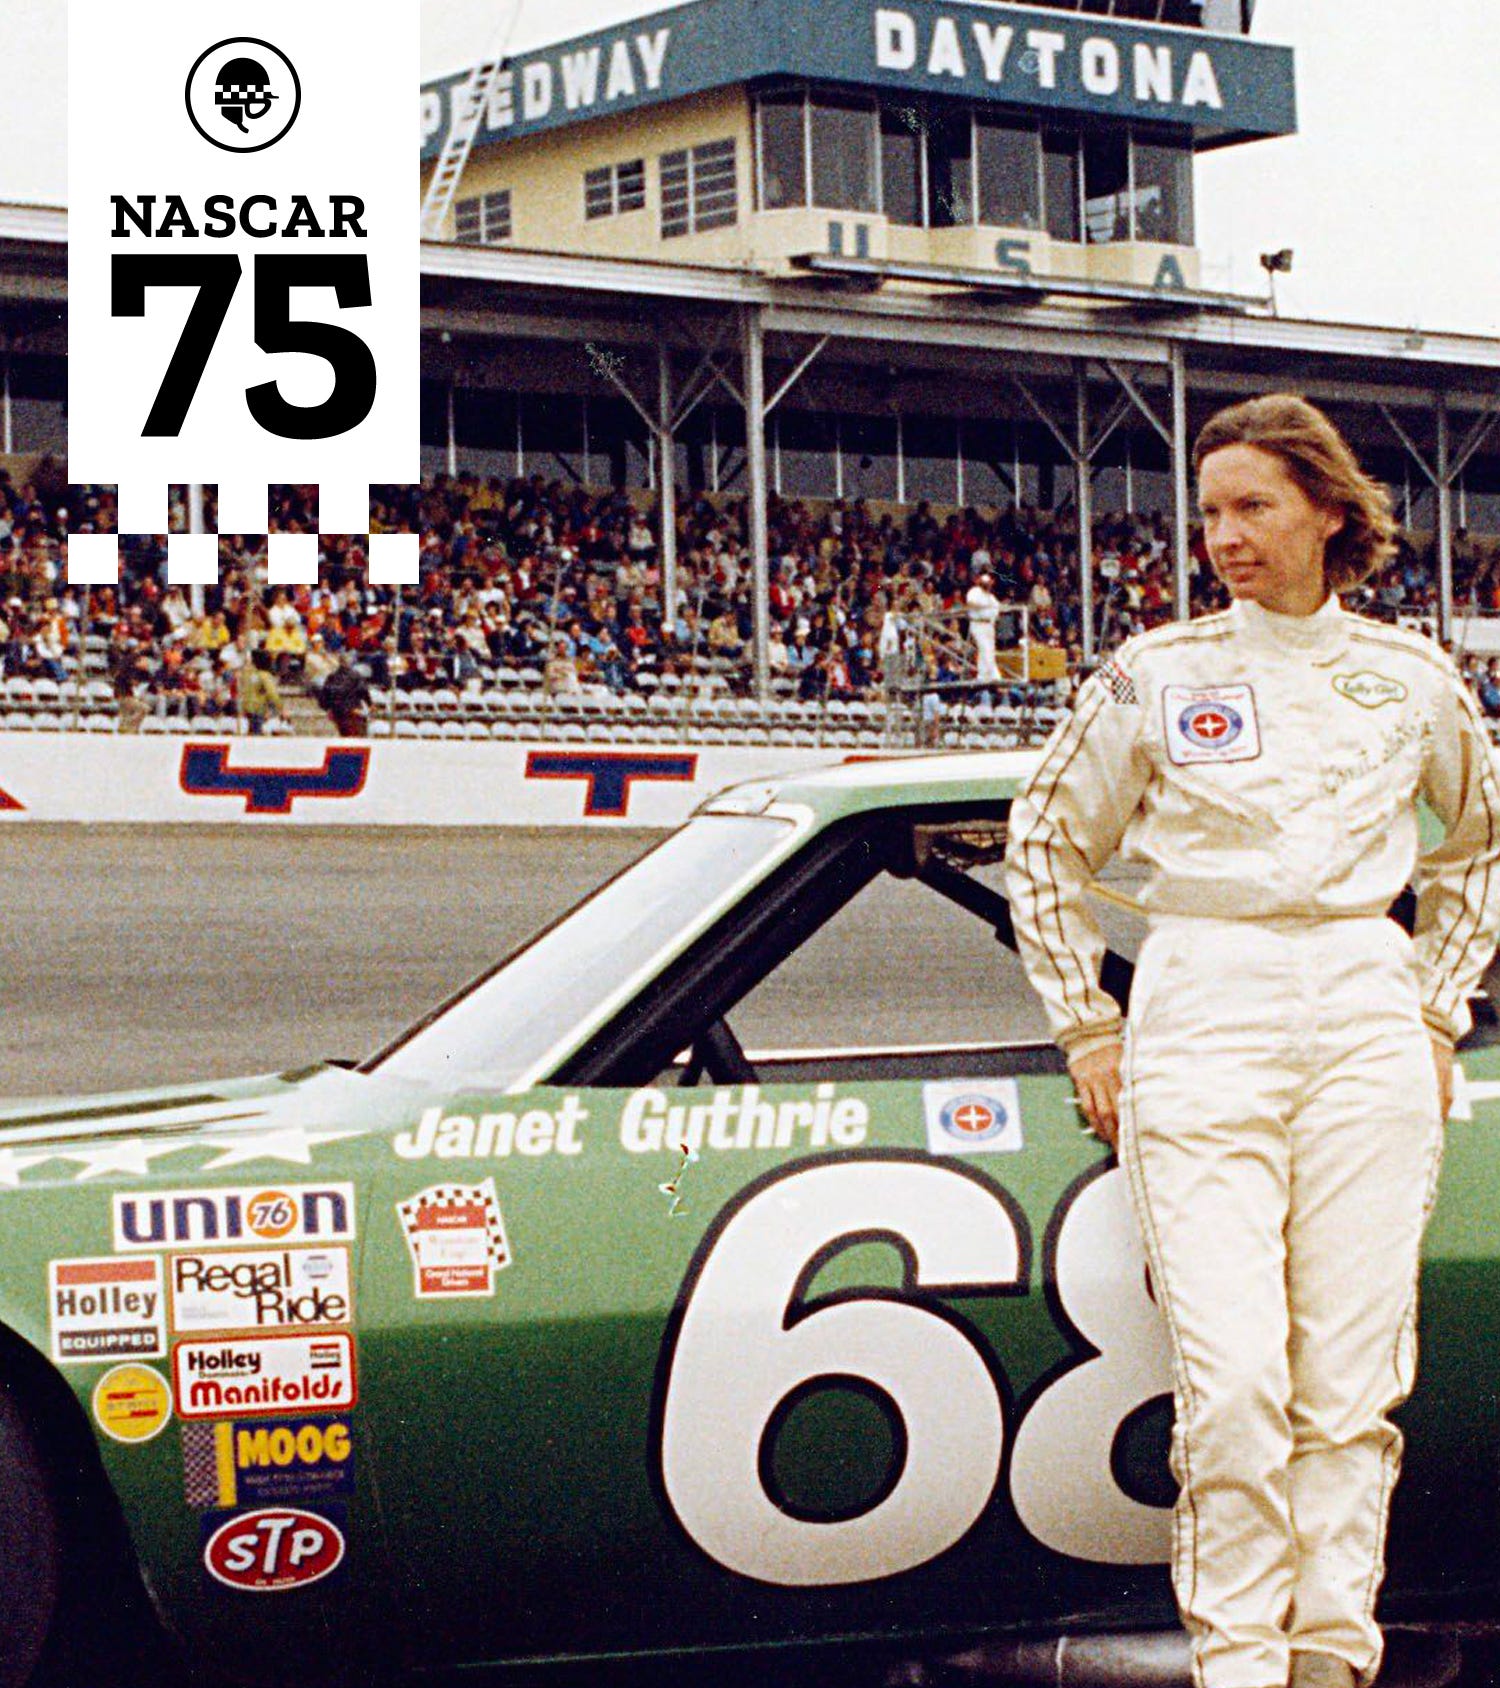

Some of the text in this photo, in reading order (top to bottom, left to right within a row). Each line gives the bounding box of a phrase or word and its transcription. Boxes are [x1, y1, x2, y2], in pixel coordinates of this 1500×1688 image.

[875, 9, 1222, 109] DAYTONA
[393, 1094, 588, 1159] Janet
[619, 1080, 869, 1153] Guthrie
[254, 1200, 290, 1227] 76
[176, 1253, 292, 1298] Regal
[56, 1286, 158, 1319] Holley
[256, 1286, 346, 1325] Ride
[62, 1333, 156, 1350] EQUIPPED
[187, 1349, 261, 1373] Holley
[190, 1374, 342, 1407] Manifolds
[237, 1423, 351, 1468] MOOG
[224, 1517, 324, 1574] STP
